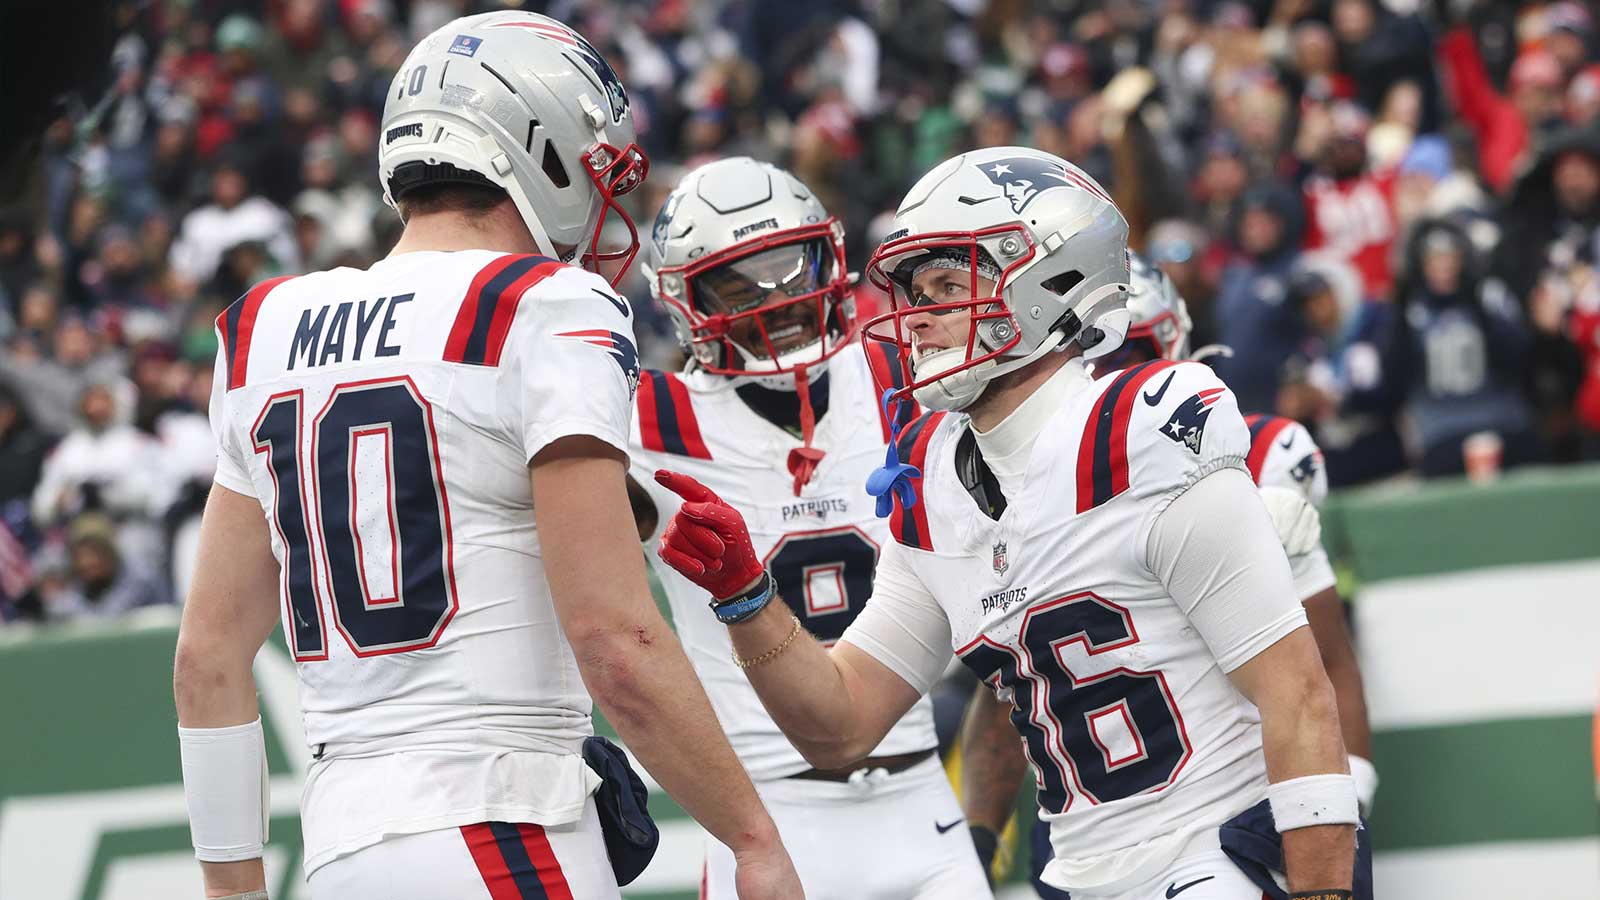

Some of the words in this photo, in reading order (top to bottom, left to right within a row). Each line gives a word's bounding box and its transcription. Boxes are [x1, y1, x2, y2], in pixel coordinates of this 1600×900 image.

[733, 218, 779, 241] PATRIOTS
[286, 292, 415, 370] MAYE
[250, 374, 459, 660] 10
[782, 498, 848, 521] PATRIOTS
[981, 586, 1027, 616] PATRIOTS
